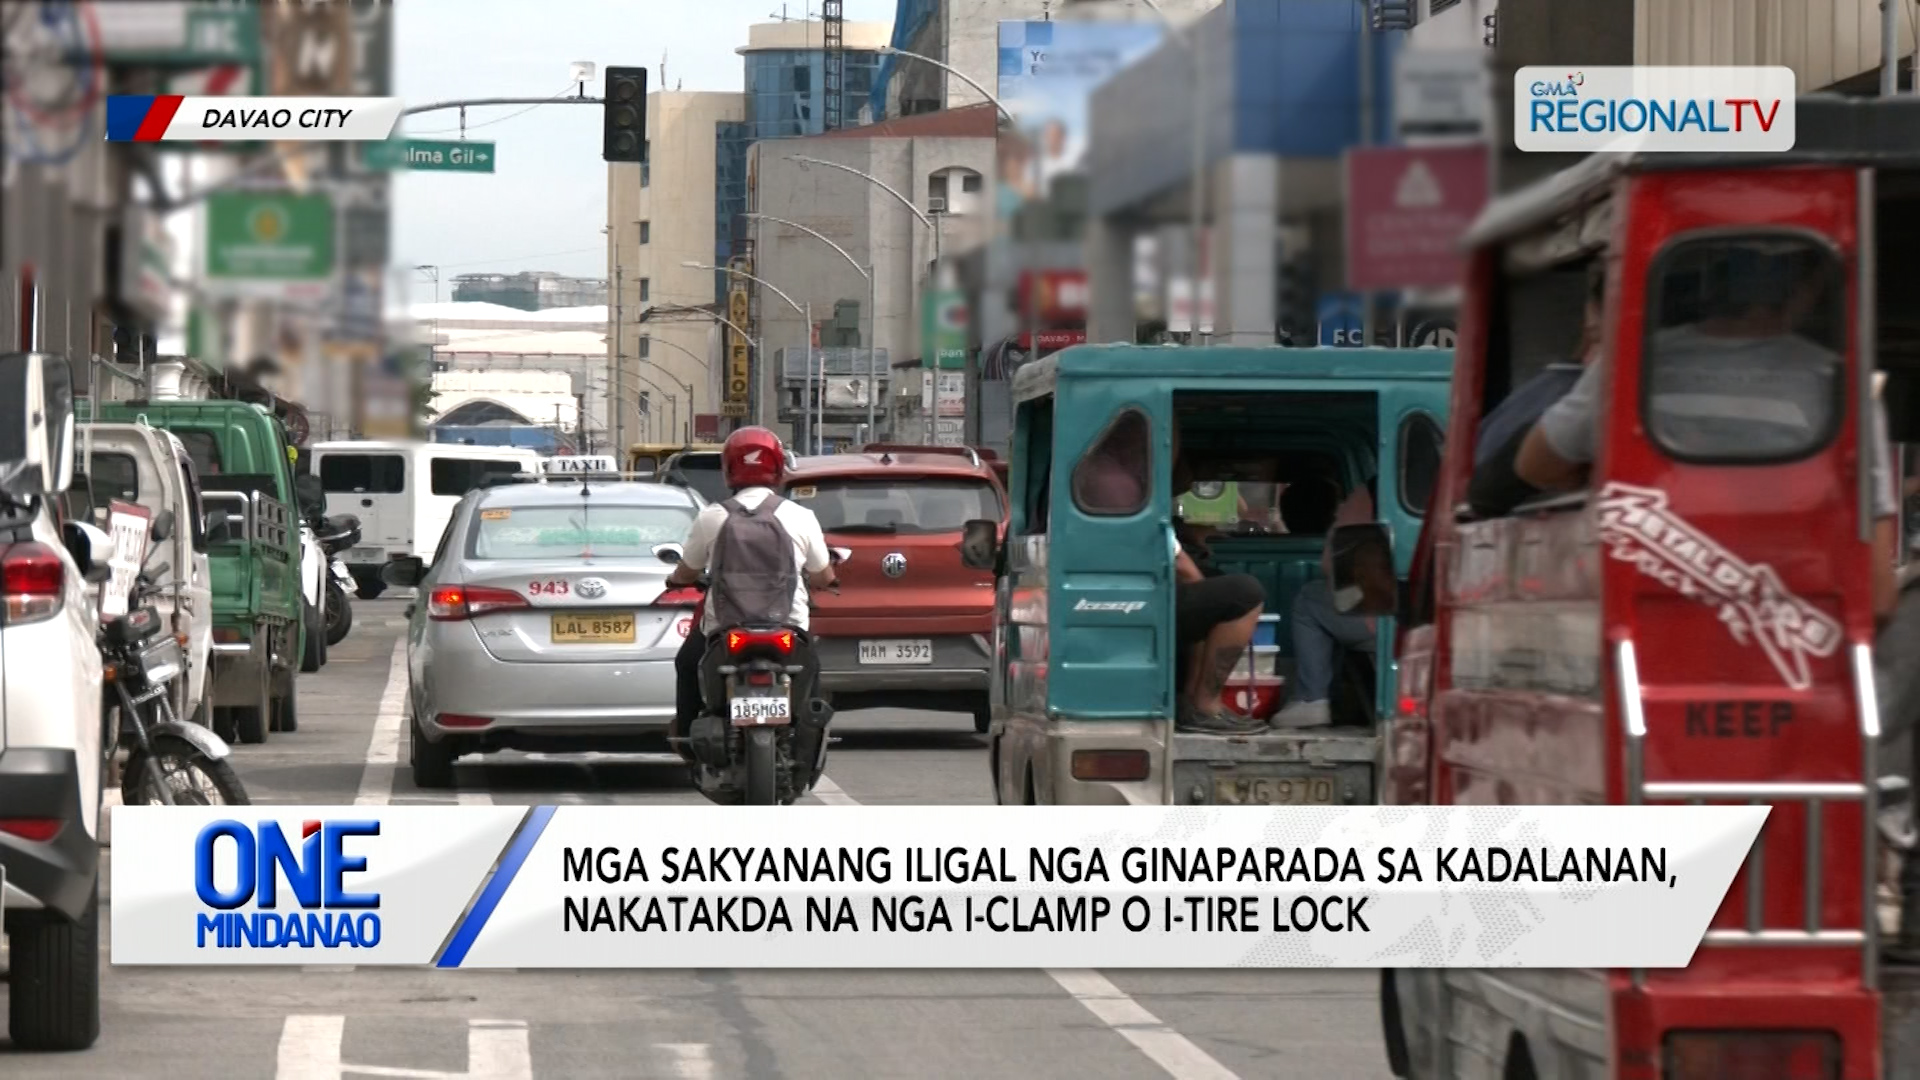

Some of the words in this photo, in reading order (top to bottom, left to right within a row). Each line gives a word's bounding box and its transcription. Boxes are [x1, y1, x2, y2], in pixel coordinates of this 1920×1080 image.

[449, 147, 474, 164] Gil
[558, 459, 600, 471] TAXI
[528, 581, 569, 595] 943
[555, 621, 587, 635] LAL
[592, 621, 631, 634] 8587
[896, 645, 929, 658] 3592
[1685, 701, 1793, 738] KEEP
[1277, 779, 1331, 802] 970
